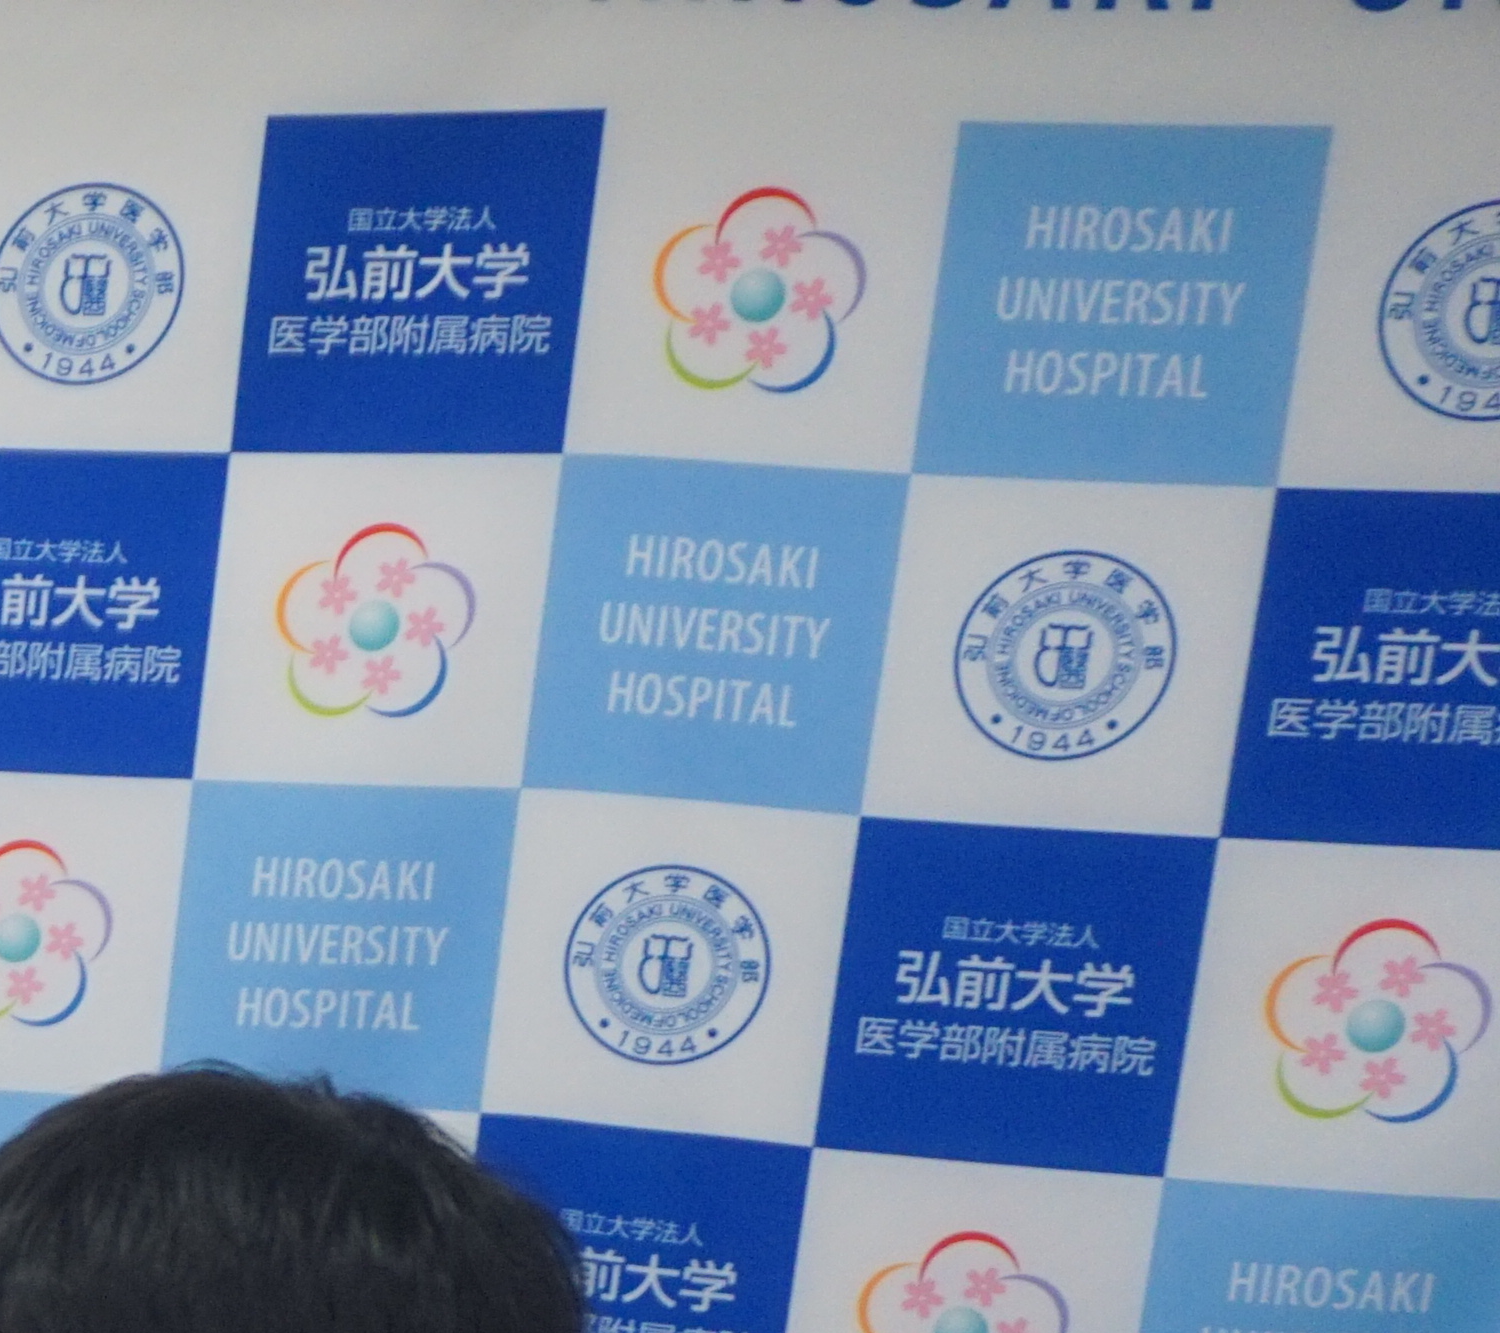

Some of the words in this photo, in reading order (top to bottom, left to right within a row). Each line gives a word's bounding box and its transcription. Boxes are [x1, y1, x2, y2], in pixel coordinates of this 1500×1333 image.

[347, 206, 496, 232] 国立大学法人
[1025, 205, 1234, 253] HIROSAKI
[304, 242, 530, 300] 弘前大学
[995, 276, 1247, 326] UNIVERSITY
[267, 314, 552, 356] 医学部附属病院
[42, 352, 116, 375] 1944
[1003, 349, 1208, 400] HOSPITAL
[625, 534, 820, 590] HIROSAKI
[599, 601, 831, 660] UNIVERSITY
[1311, 625, 1500, 686] 弘前大
[607, 670, 797, 728] HOSPITAL
[1266, 697, 1500, 746] 医学部附属
[1011, 727, 1095, 750] 1944
[251, 856, 436, 901] HIROSAKI
[227, 921, 450, 966] UNIVERSITY
[942, 916, 1099, 949] 国立大学法人
[895, 949, 1135, 1018] 弘前大学
[236, 987, 420, 1032] HOSPITAL
[619, 1031, 697, 1055] 1944
[855, 1016, 1157, 1077] 医学部附属病院
[578, 1247, 738, 1312] 前大学
[1226, 1261, 1436, 1314] HIROSAKI
